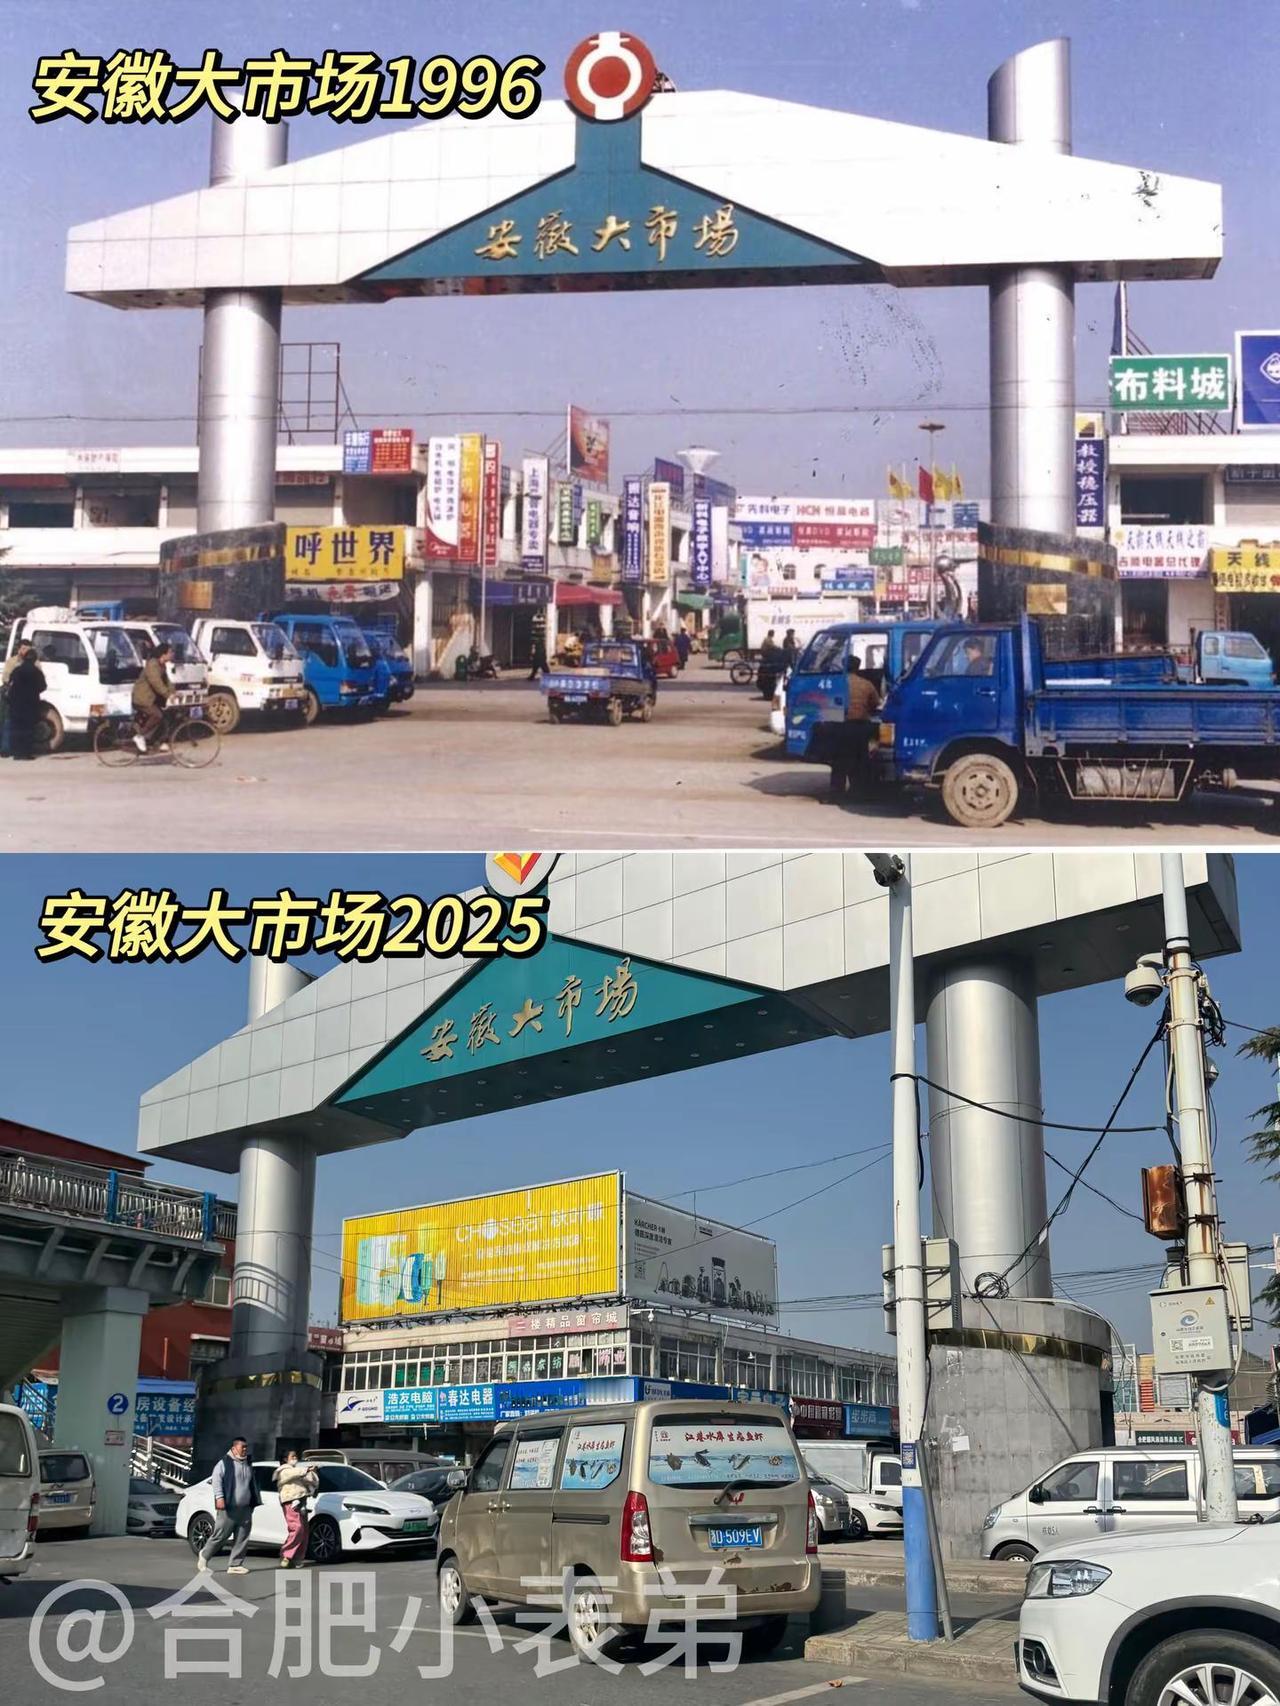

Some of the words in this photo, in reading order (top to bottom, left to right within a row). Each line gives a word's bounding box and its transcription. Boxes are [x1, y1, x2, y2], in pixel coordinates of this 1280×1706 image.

[1113, 366, 1227, 402] 布料城
[1077, 442, 1099, 524] 教授稳压器
[295, 530, 396, 566] 呼世界
[514, 1313, 619, 1332] 二楼精品窗帘城
[111, 1394, 125, 1413] 2
[388, 1391, 434, 1405] 浩友电脑
[447, 1387, 494, 1407] 春达电器
